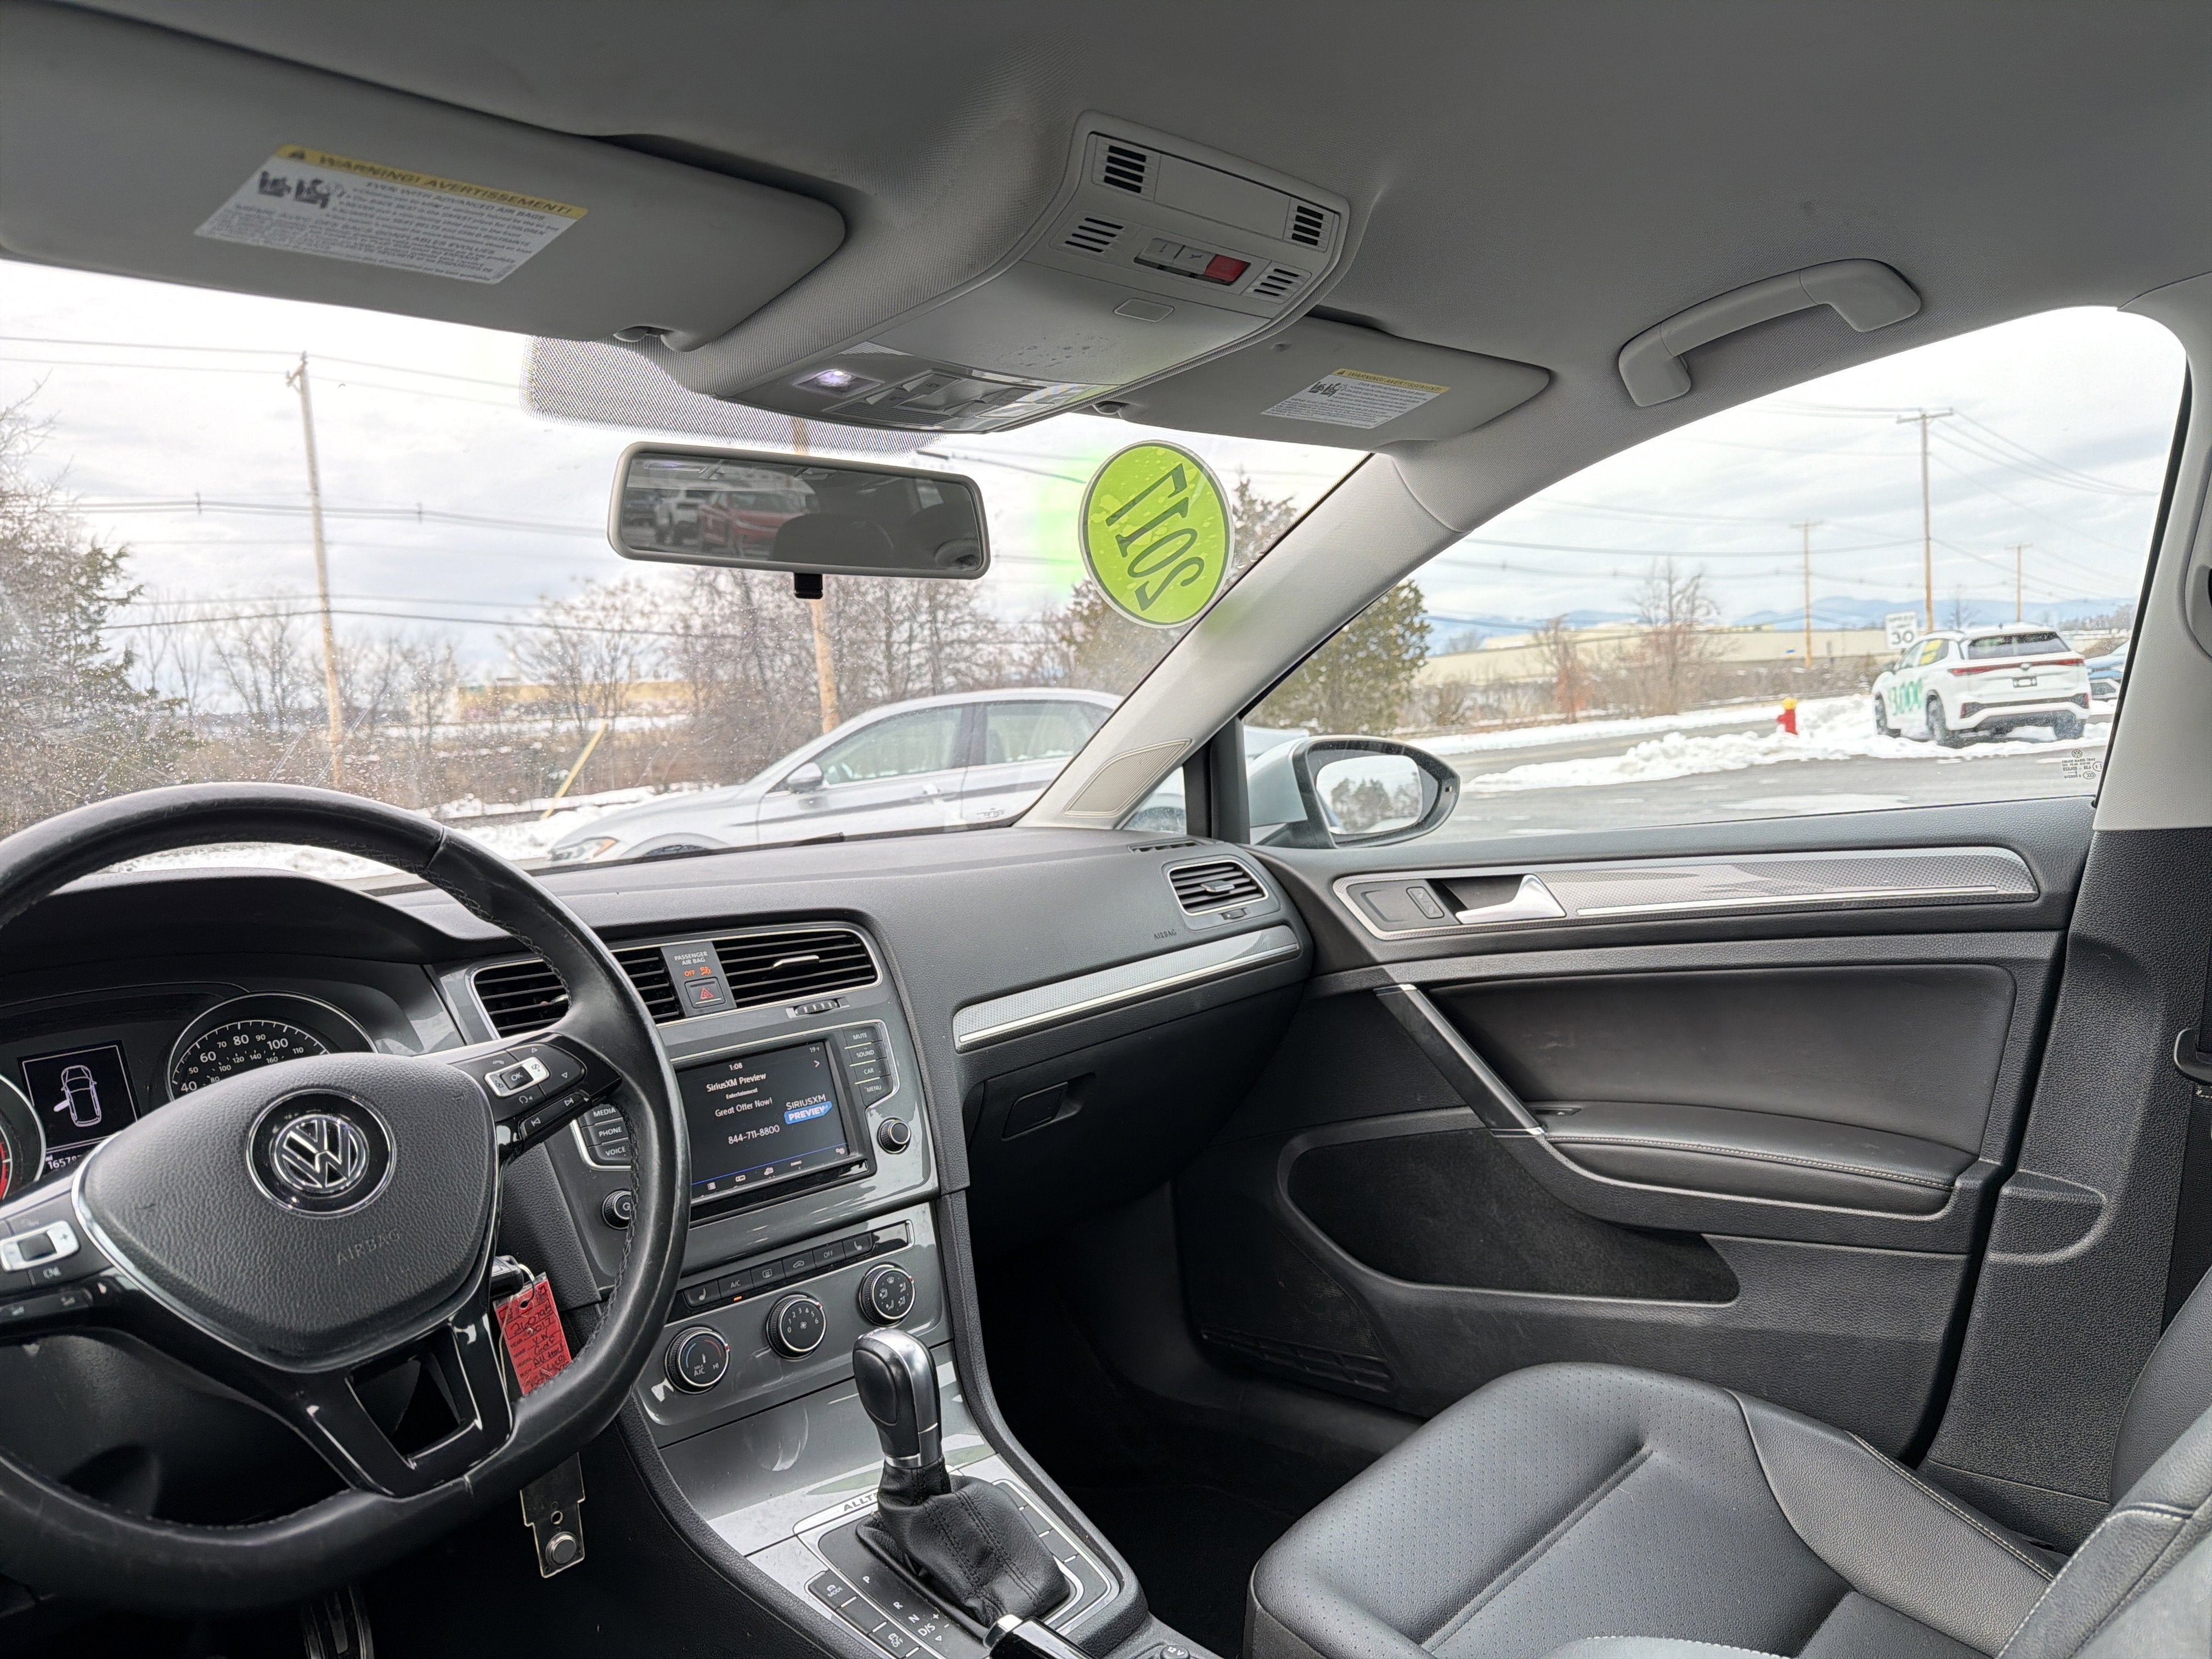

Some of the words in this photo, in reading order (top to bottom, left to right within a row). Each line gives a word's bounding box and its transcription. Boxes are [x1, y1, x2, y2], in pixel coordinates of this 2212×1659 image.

[319, 156, 422, 183] WARNING!
[426, 179, 573, 215] AVERTISSEMENT!
[515, 211, 547, 221] BAGS
[1891, 630, 1915, 645] 30
[1154, 929, 1177, 940] AIRBAG
[674, 951, 708, 961] PASSENGER
[233, 1034, 249, 1046] 80
[853, 1032, 868, 1040] MUTE
[267, 1037, 289, 1050] 100
[200, 1051, 216, 1063] 60
[249, 1052, 262, 1060] 140
[856, 1049, 875, 1058] SOUND
[266, 1056, 279, 1064] 160
[511, 1072, 523, 1082] OK
[706, 1078, 738, 1092] SiriusXM
[738, 1073, 766, 1085] Preview
[180, 1081, 197, 1092] 40
[867, 1085, 882, 1093] MENU
[725, 1087, 758, 1100] Entertainment
[715, 1106, 735, 1117] Great
[736, 1103, 753, 1112] Offer
[754, 1097, 772, 1108] Now!
[786, 1093, 826, 1110] SIRIUSXM
[593, 1107, 616, 1118] MEDIA
[788, 1105, 828, 1121] PREVIEW
[599, 1126, 623, 1137] PHONE
[728, 1125, 780, 1144] 844-711-8800
[605, 1146, 627, 1156] VOICE
[337, 1228, 400, 1265] AIRBAG
[823, 1250, 834, 1259] OFF
[730, 1279, 741, 1289] A/C
[694, 1367, 706, 1377] A/C
[843, 1492, 878, 1512] ALLT
[862, 1576, 870, 1584] P
[827, 1586, 844, 1598] MODE
[893, 1601, 904, 1610] R
[908, 1613, 920, 1623] N
[917, 1622, 936, 1637] D/S
[892, 1637, 904, 1648] OFF
